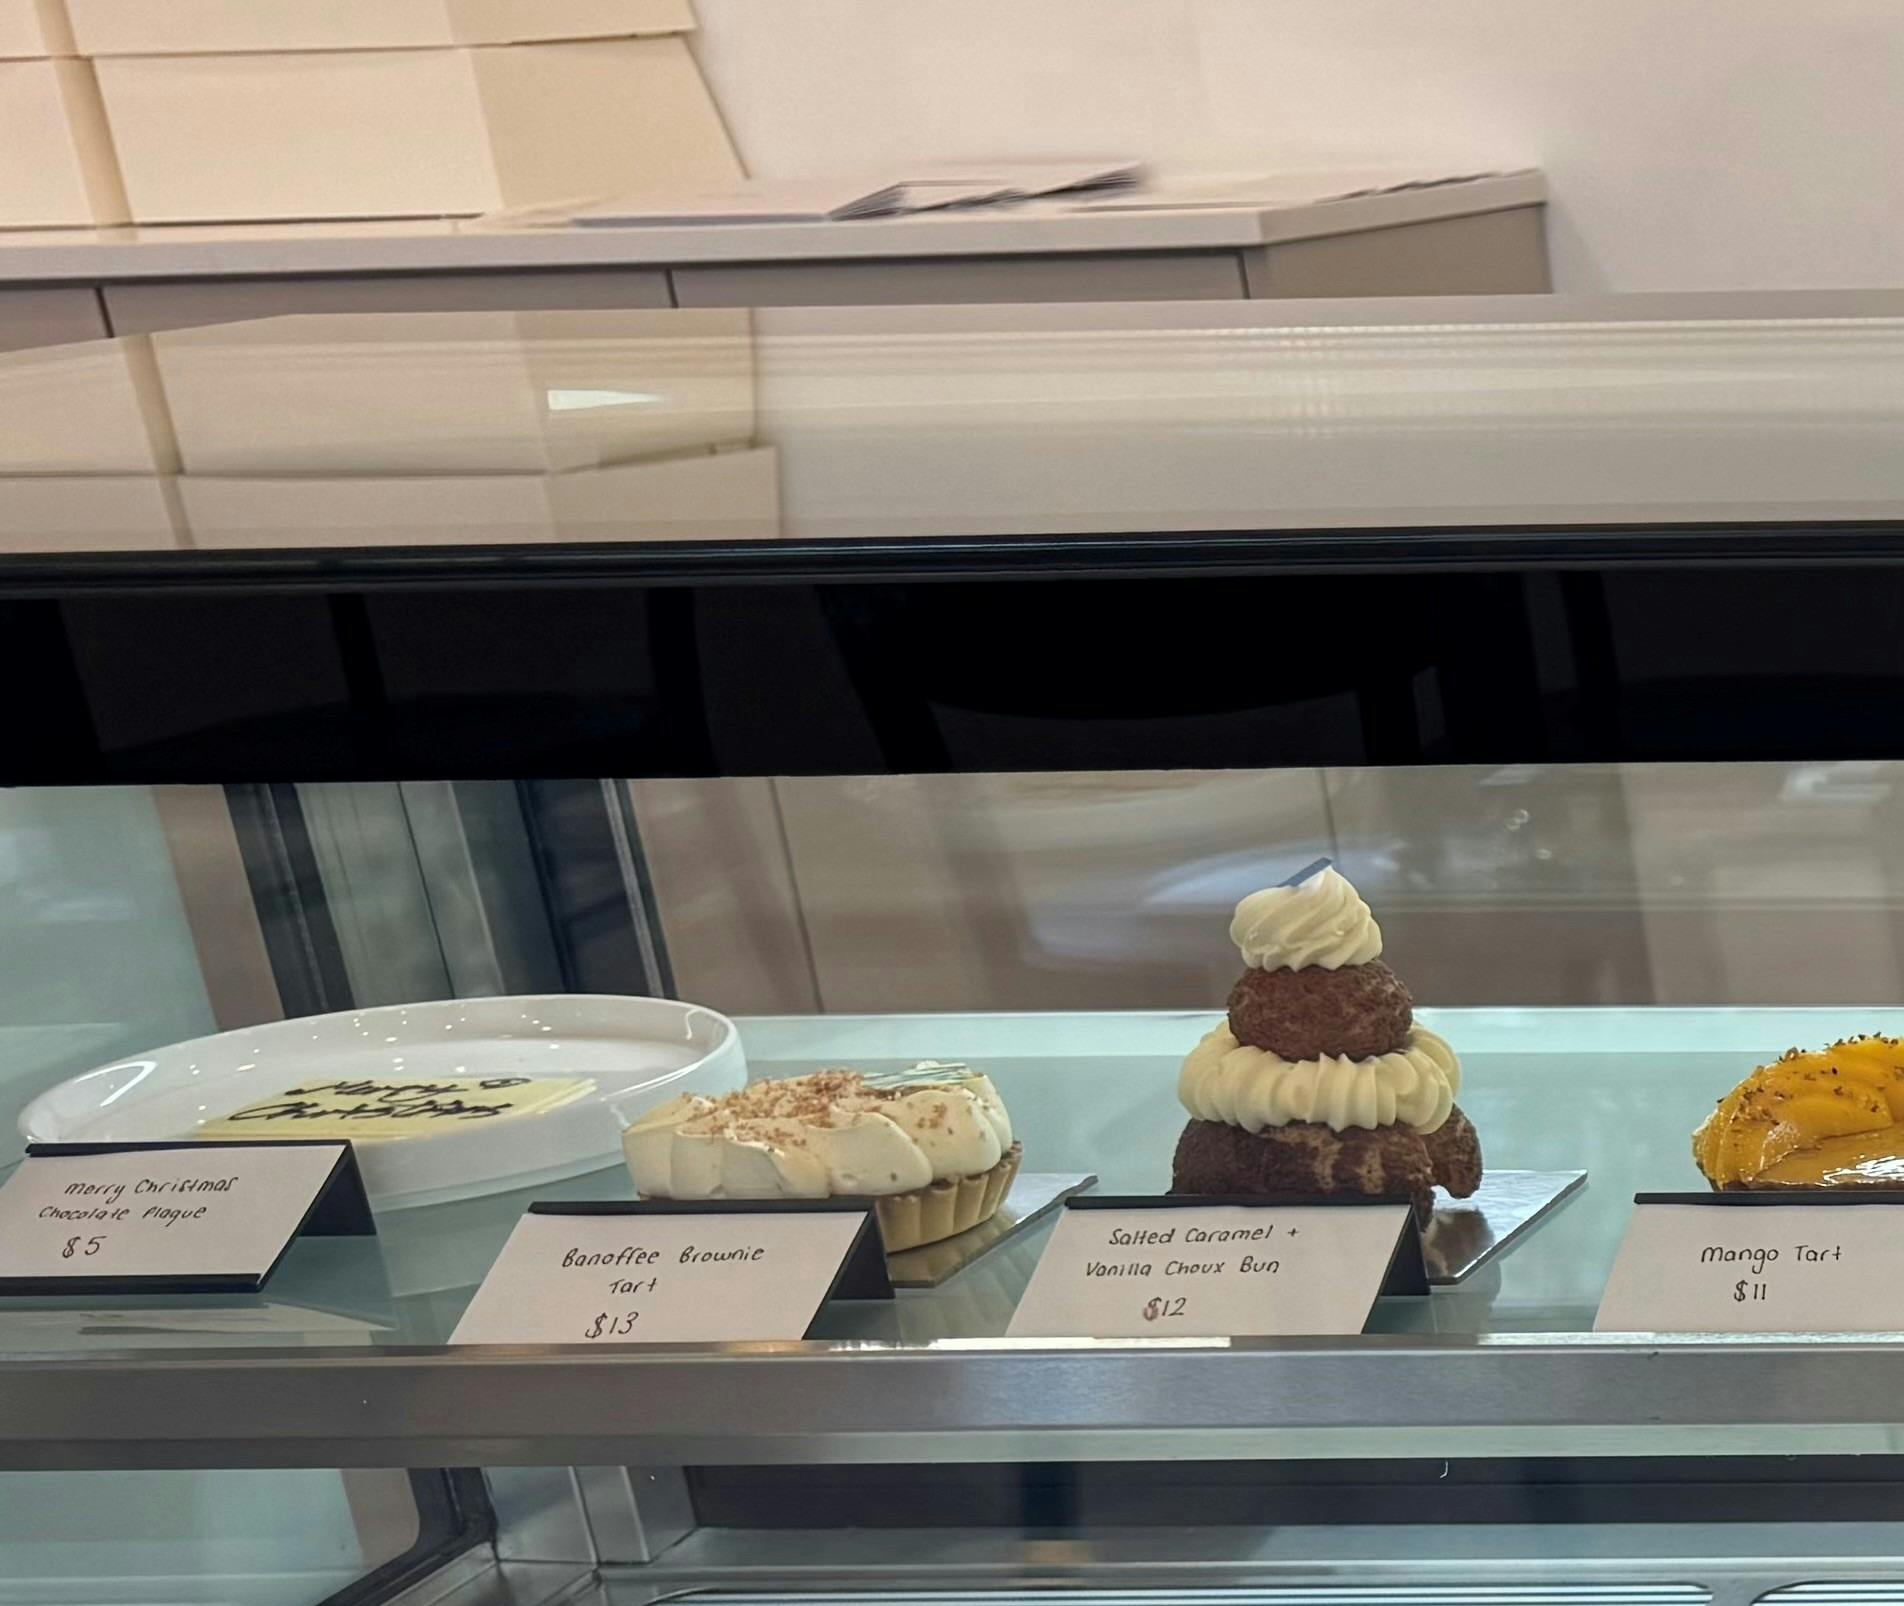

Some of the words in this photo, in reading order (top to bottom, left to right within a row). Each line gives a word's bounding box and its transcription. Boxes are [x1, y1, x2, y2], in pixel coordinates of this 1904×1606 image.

[134, 1176, 240, 1195] Christmas
[39, 1206, 130, 1221] Chocolate
[142, 1206, 207, 1227] Plaque
[1108, 1228, 1176, 1246] Salted
[1185, 1224, 1273, 1244] Caramel
[62, 1235, 107, 1259] $5
[562, 1246, 660, 1268] Banoffee
[679, 1245, 765, 1264] Brownie
[1794, 1244, 1843, 1262] Tart
[1085, 1261, 1152, 1278] Vanilla
[1165, 1260, 1225, 1276] Choux
[1239, 1255, 1280, 1274] Bun
[609, 1277, 658, 1295] Tart
[1733, 1279, 1767, 1302] $11
[1142, 1296, 1187, 1322] $12
[585, 1310, 639, 1339] $13
